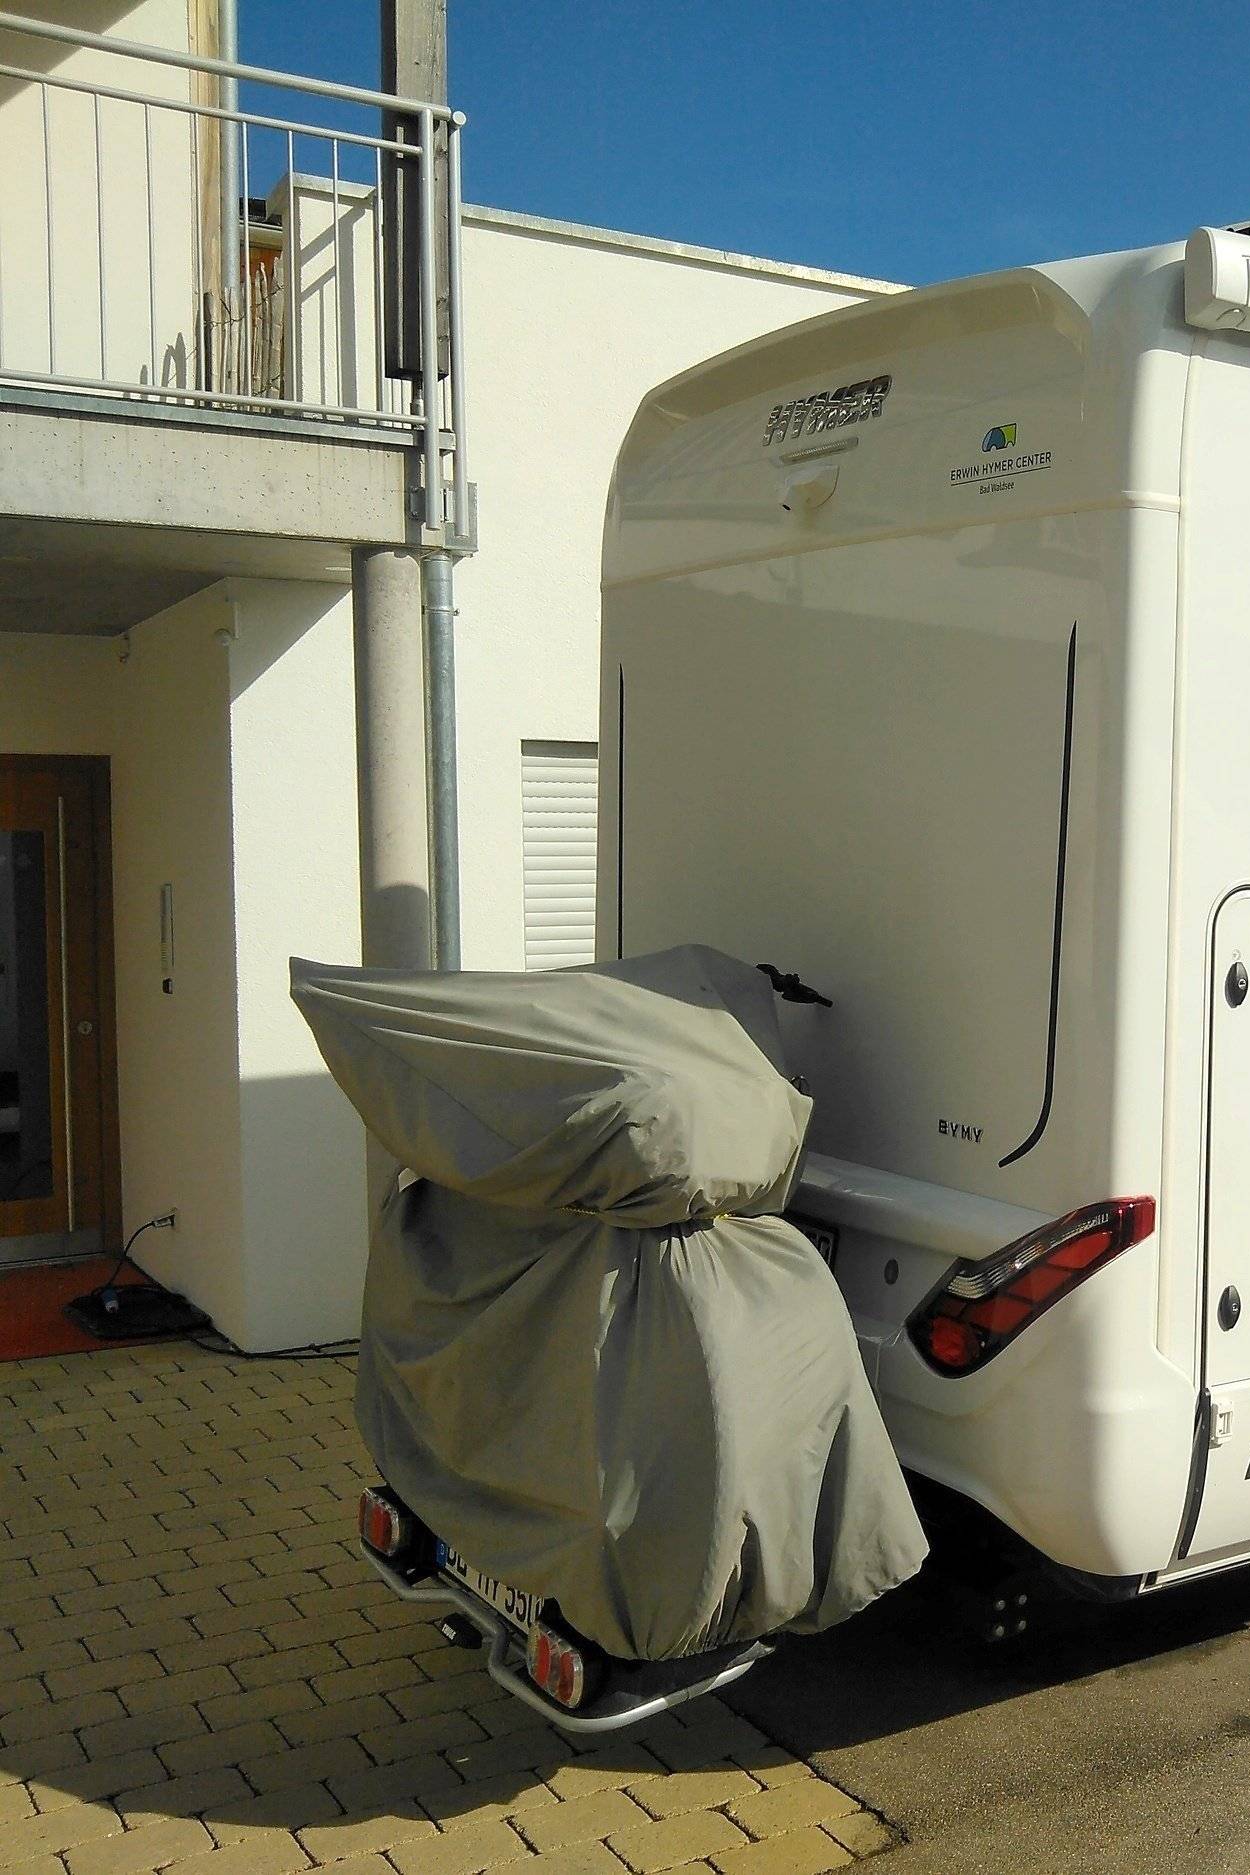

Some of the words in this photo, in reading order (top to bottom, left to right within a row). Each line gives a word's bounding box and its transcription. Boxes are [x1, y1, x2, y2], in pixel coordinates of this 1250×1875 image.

[762, 374, 893, 447] HYMER
[950, 466, 980, 481] ERWIN
[982, 459, 1014, 475] HYMER
[1016, 452, 1052, 469] CENTER
[980, 483, 990, 495] Bad
